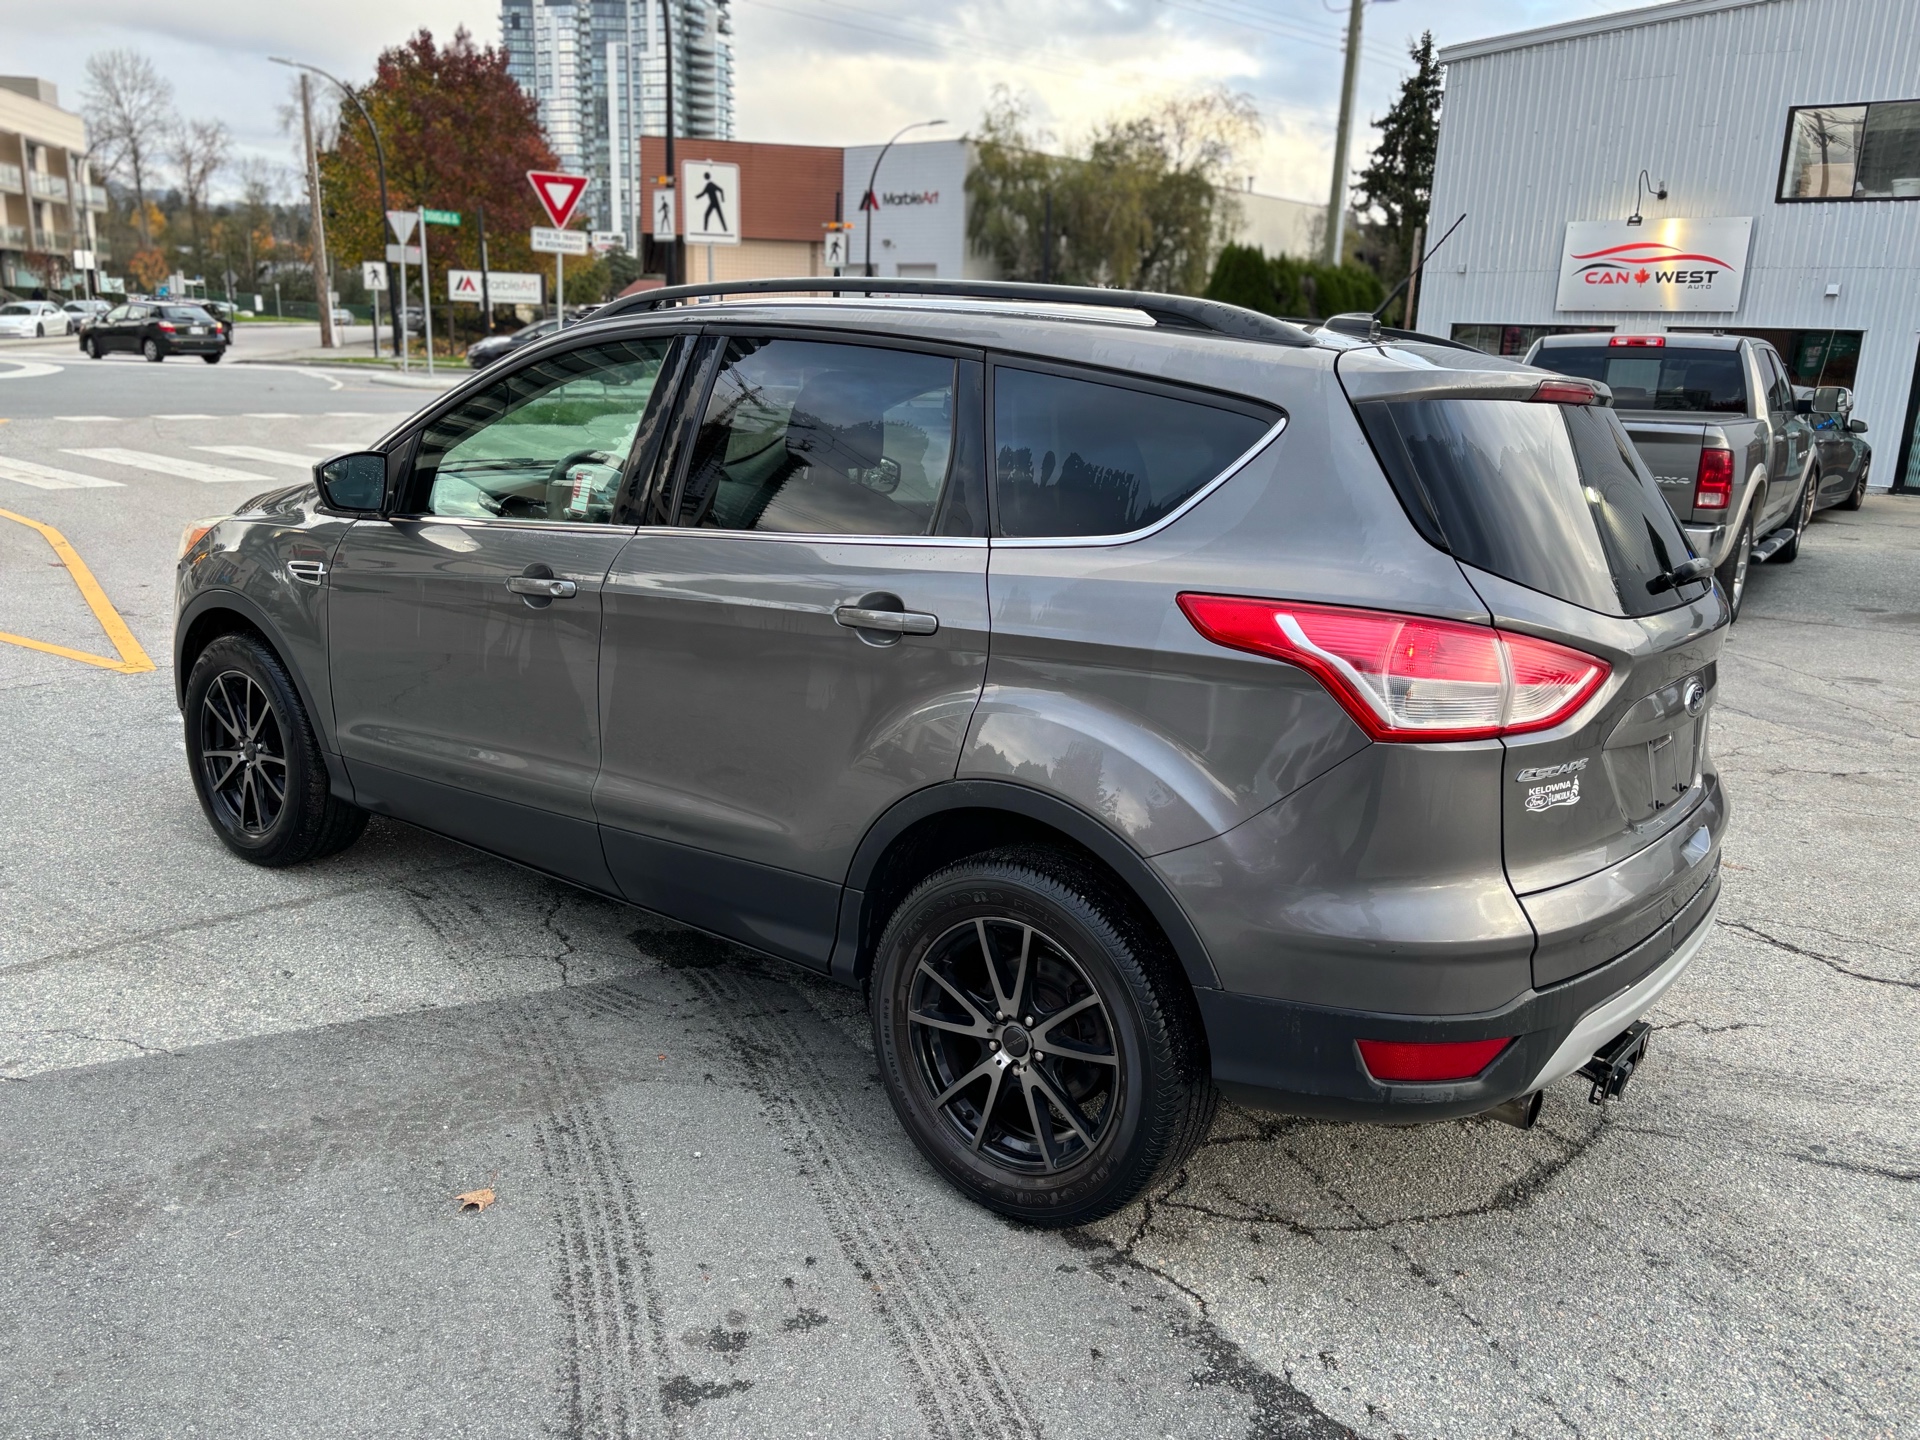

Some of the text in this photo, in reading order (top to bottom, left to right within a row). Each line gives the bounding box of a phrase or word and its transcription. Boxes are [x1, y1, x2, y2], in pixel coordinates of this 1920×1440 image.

[882, 191, 939, 206] MarbleArt
[1584, 270, 1719, 285] CAN WEST
[1515, 757, 1589, 782] ESCAPE
[1528, 780, 1571, 796] KELOWNA
[1527, 796, 1547, 808] Ford
[1552, 790, 1571, 802] LINCOLN
